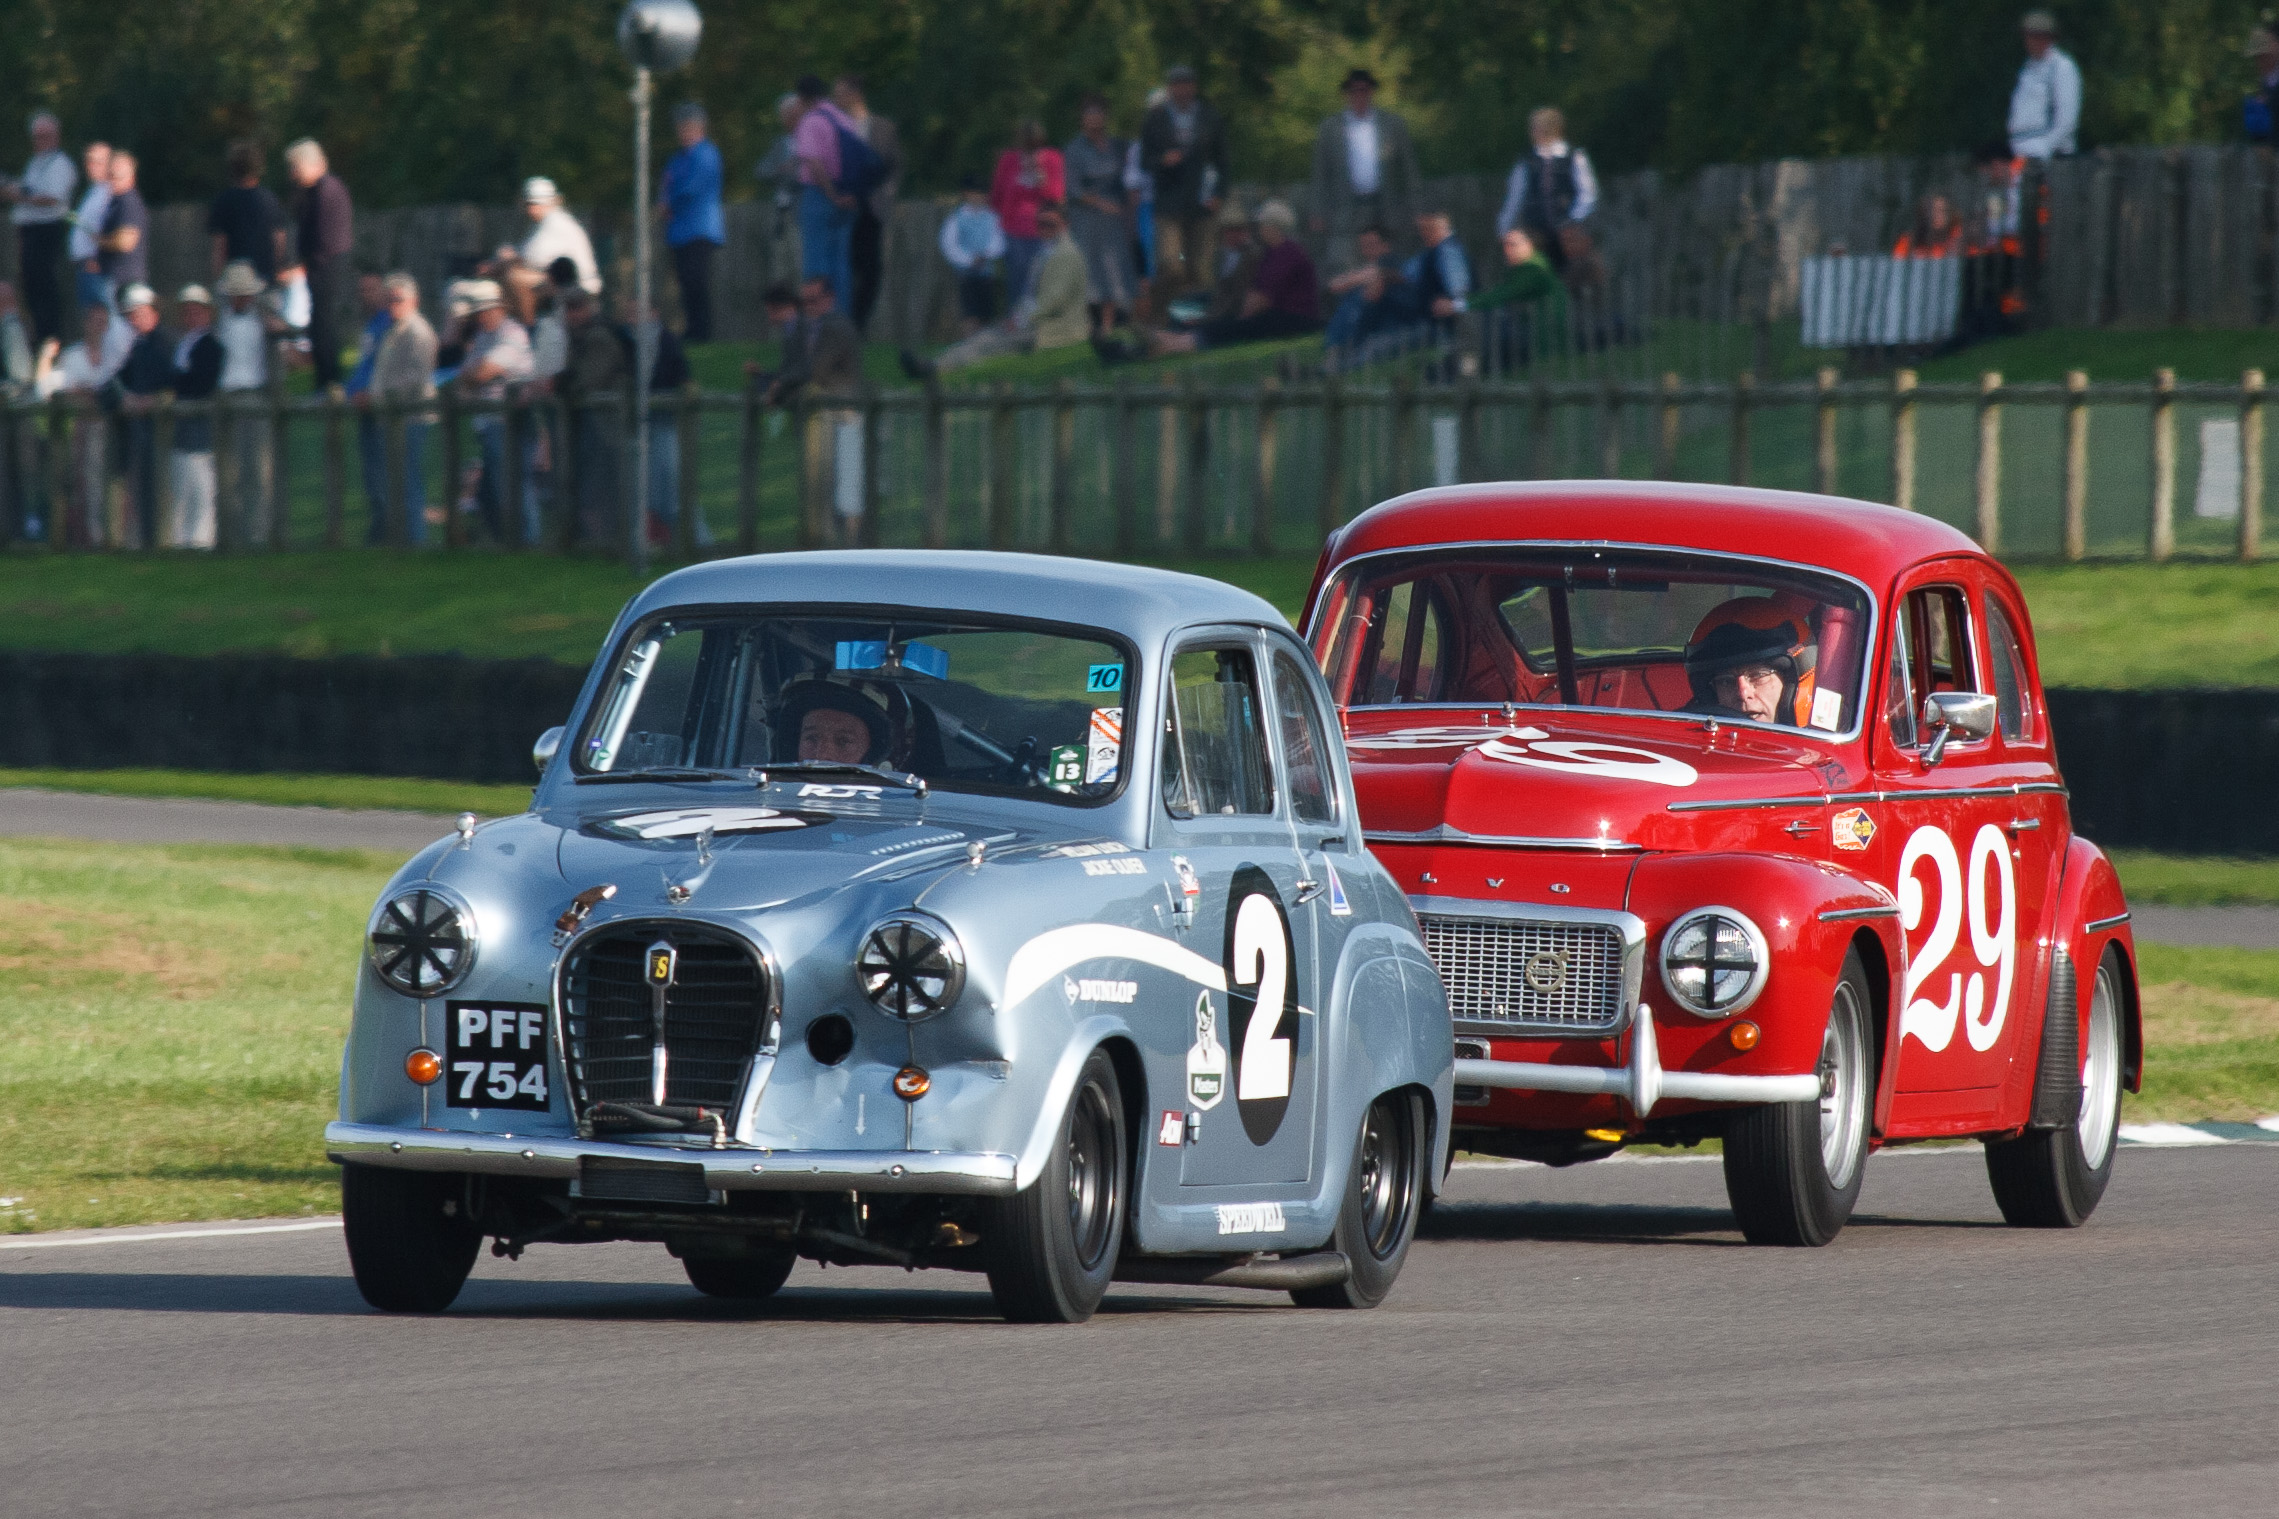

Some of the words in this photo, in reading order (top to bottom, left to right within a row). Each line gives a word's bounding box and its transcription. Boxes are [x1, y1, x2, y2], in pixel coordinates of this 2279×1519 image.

[1091, 667, 1119, 688] 10
[1055, 763, 1080, 780] 13
[1898, 824, 2015, 1053] 29
[1079, 980, 1138, 1003] DUNLOP
[1234, 893, 1290, 1100] 2
[458, 1008, 543, 1049] PFF
[453, 1061, 548, 1102] 754
[1218, 1202, 1287, 1235] SPEEDWELL
